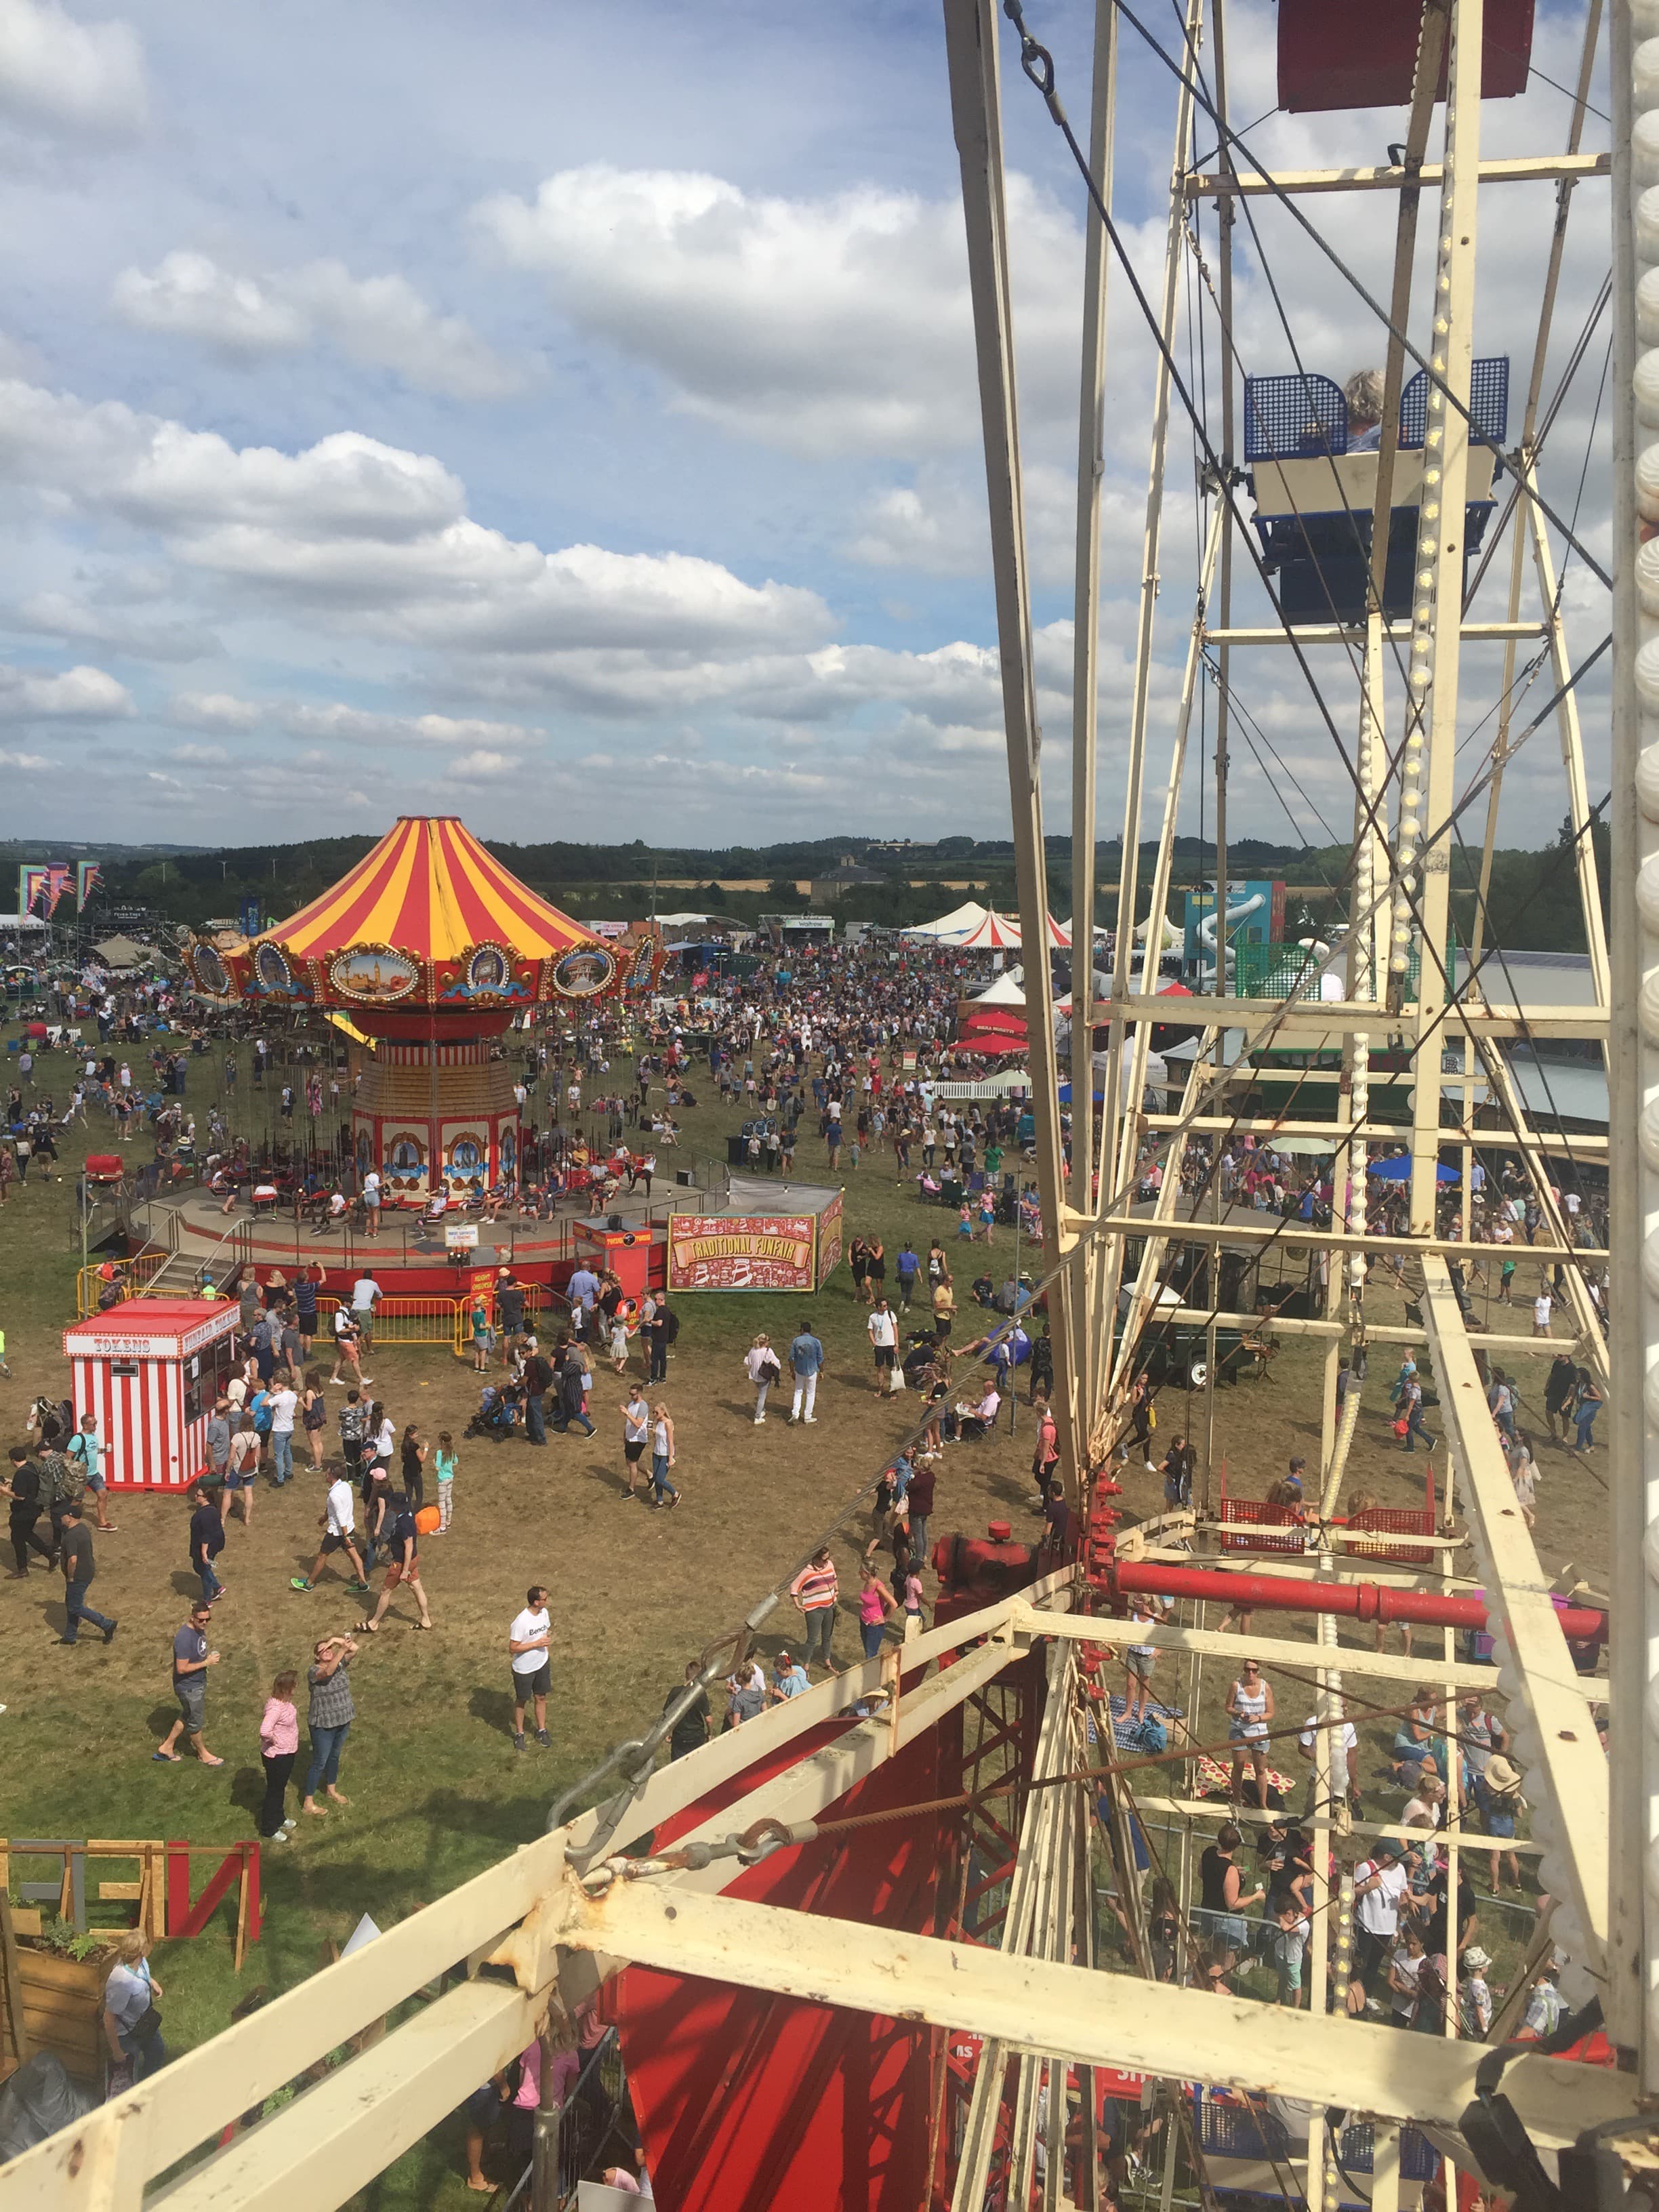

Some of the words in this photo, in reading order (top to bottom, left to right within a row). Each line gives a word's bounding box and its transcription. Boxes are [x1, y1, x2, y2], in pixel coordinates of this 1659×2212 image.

[690, 1237, 752, 1259] TRADITIONAL
[755, 1237, 796, 1259] FUNFAIR
[184, 1323, 213, 1351] FUNFAIR
[215, 1307, 238, 1333] TOKENS
[94, 1338, 150, 1353] TOKENS
